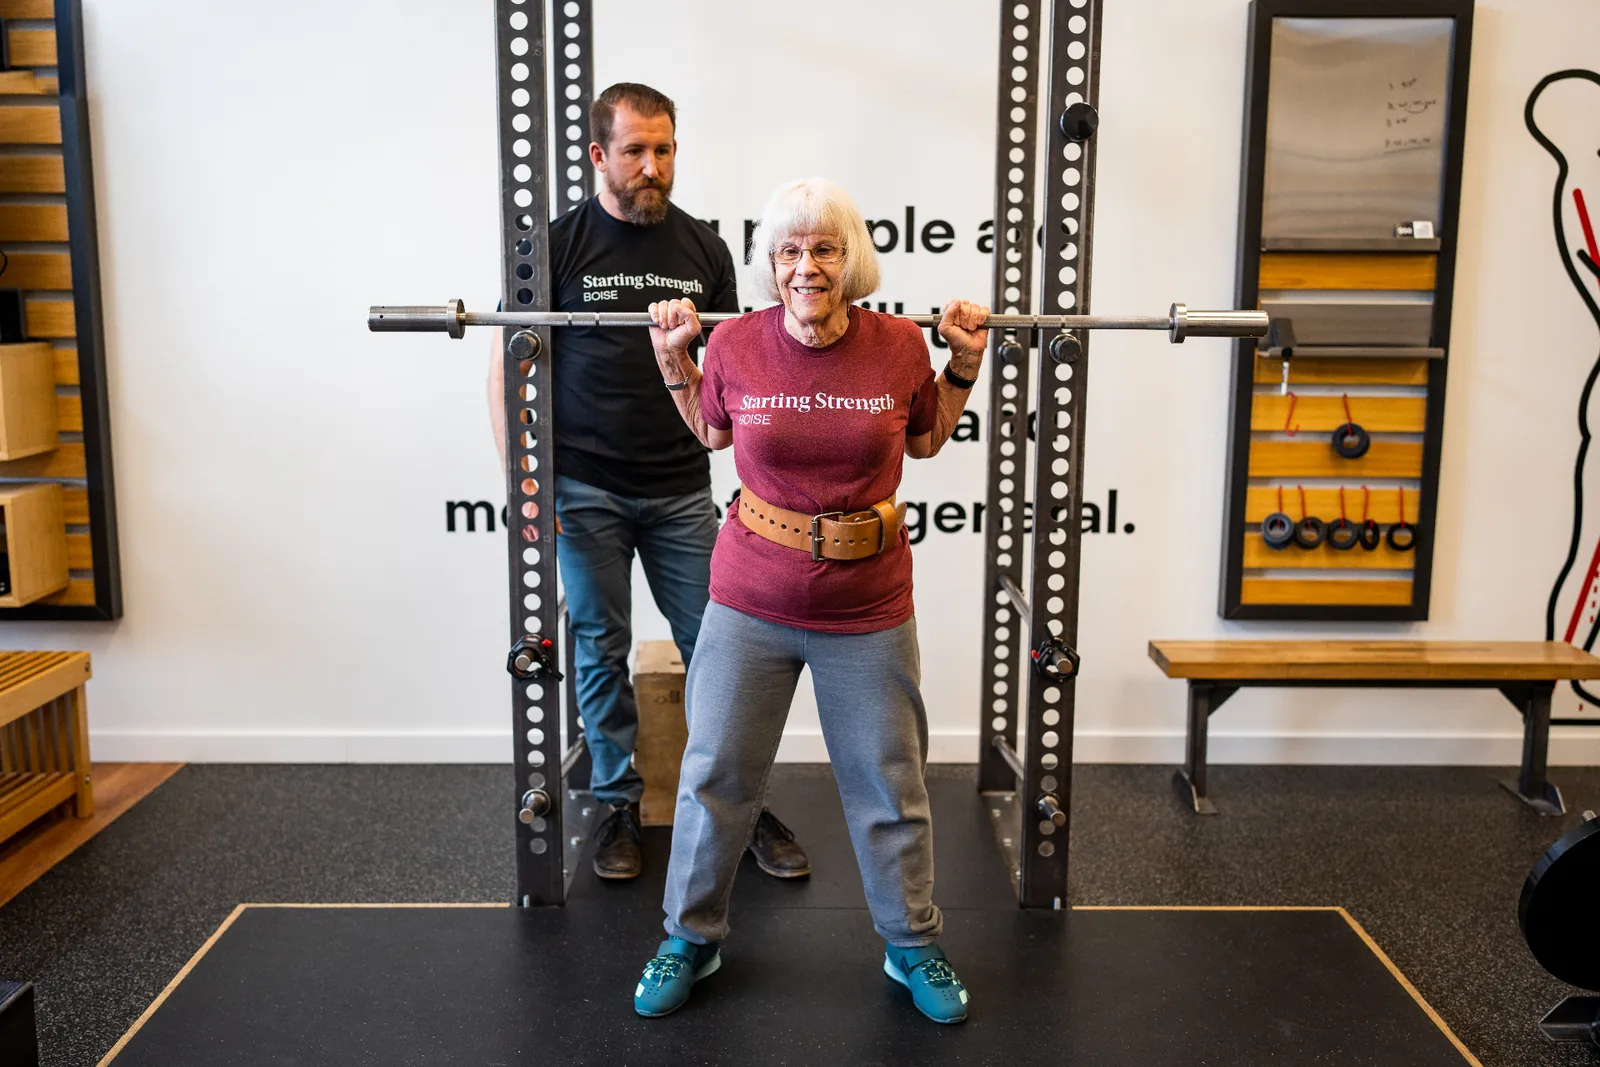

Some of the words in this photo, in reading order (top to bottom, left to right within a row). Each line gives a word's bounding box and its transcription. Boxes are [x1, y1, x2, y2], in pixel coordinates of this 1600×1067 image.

[583, 273, 644, 289] Starting
[645, 273, 703, 294] Strength
[583, 290, 619, 302] BOISE
[740, 393, 811, 412] Starting
[815, 392, 895, 414] Strength
[738, 414, 772, 425] BOISE
[904, 489, 1136, 546] genal.
